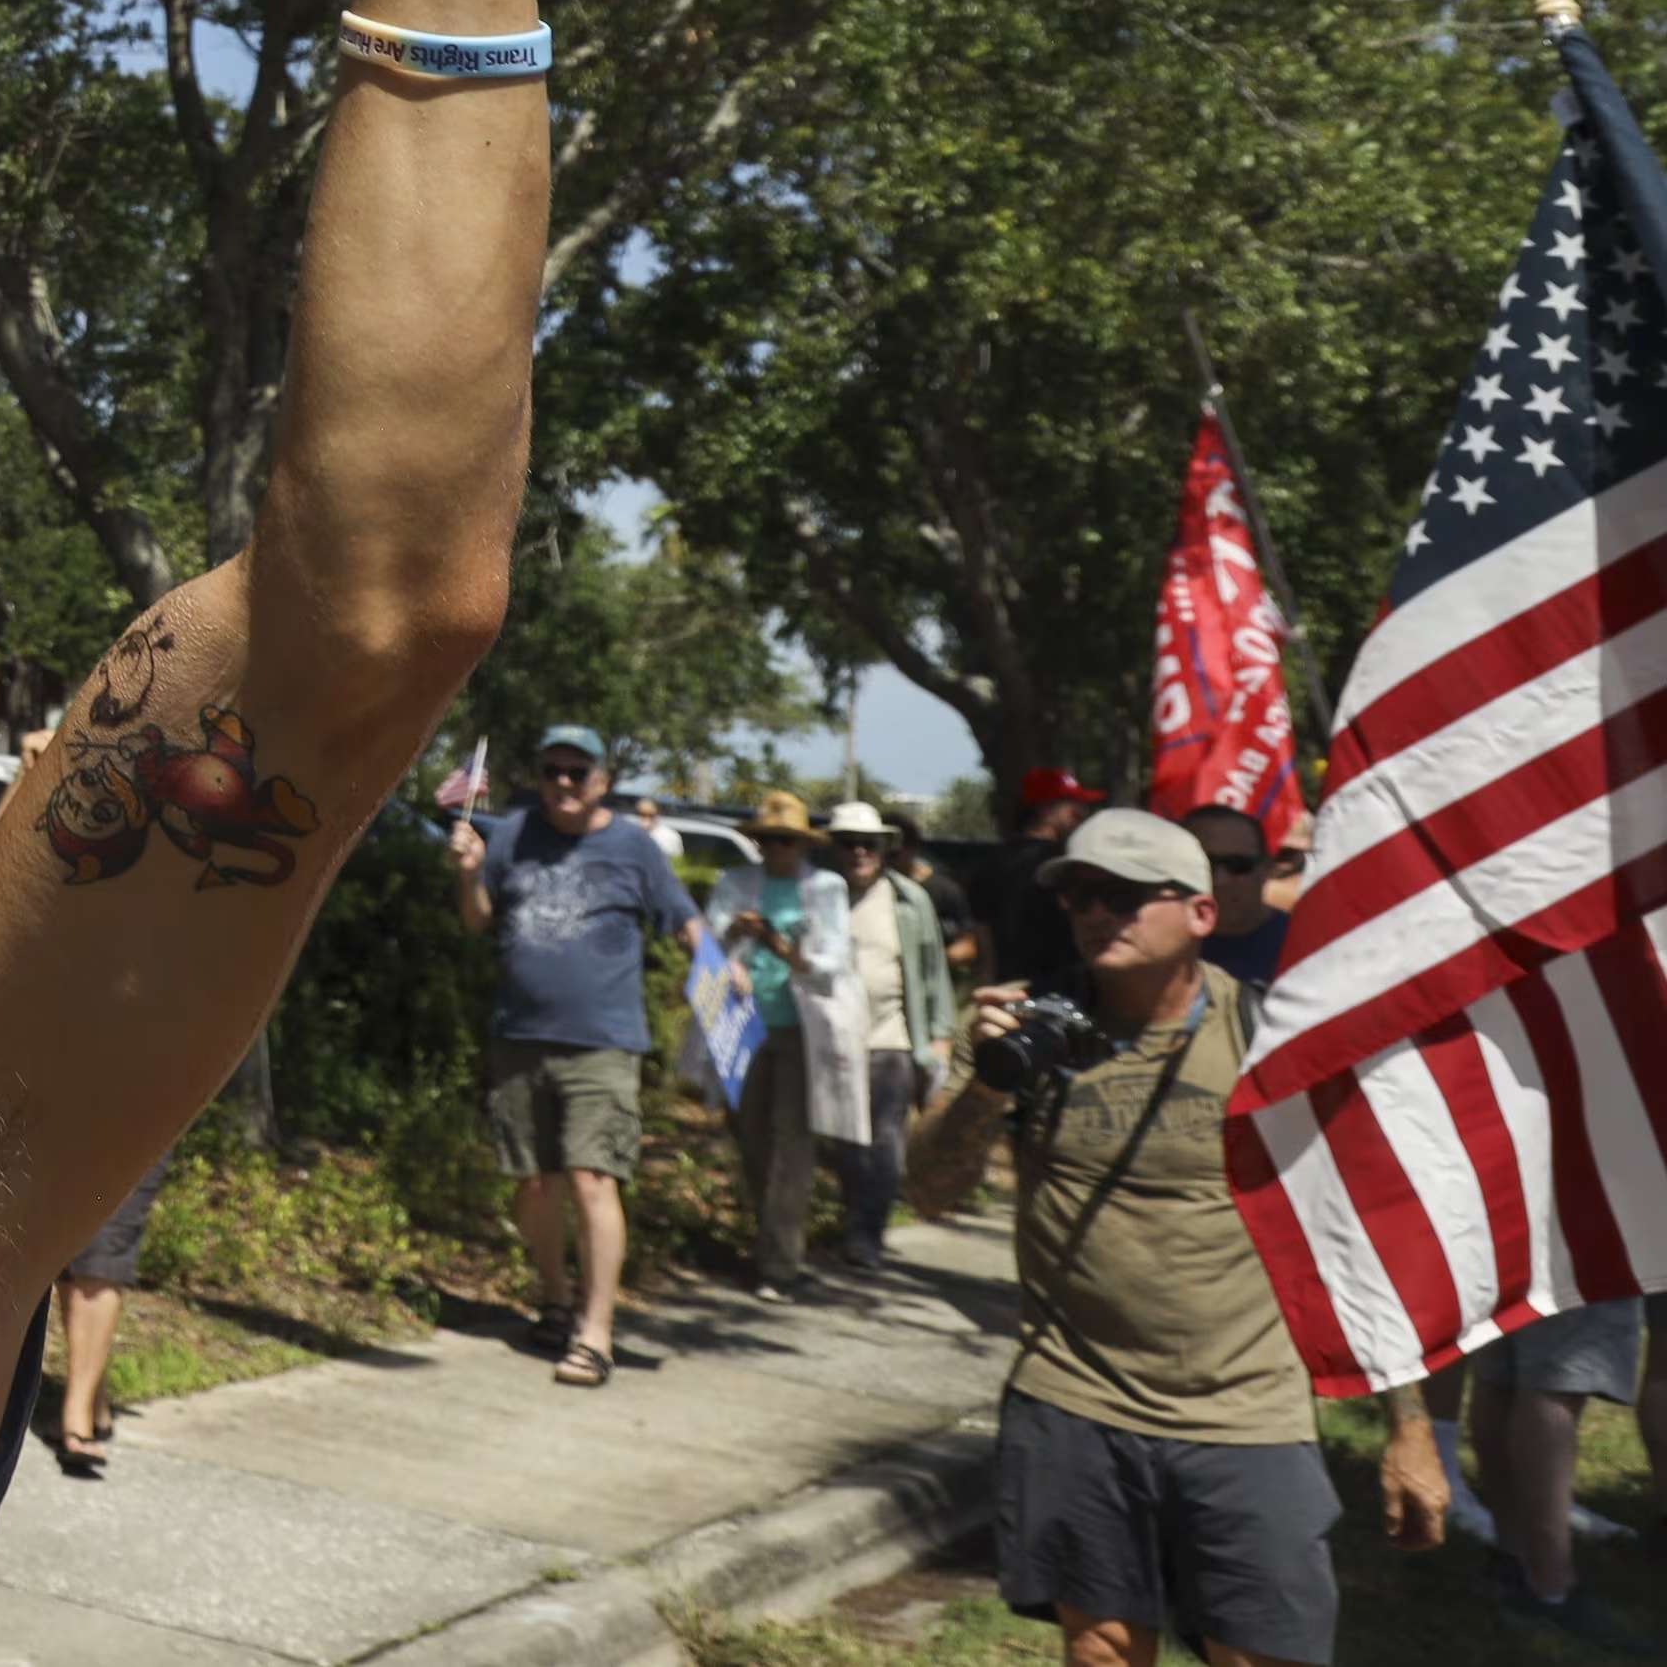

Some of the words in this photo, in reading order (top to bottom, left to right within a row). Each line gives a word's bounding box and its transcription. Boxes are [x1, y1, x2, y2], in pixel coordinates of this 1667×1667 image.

[374, 37, 405, 62] Are
[411, 43, 479, 72] Rights
[485, 47, 538, 66] Trans
